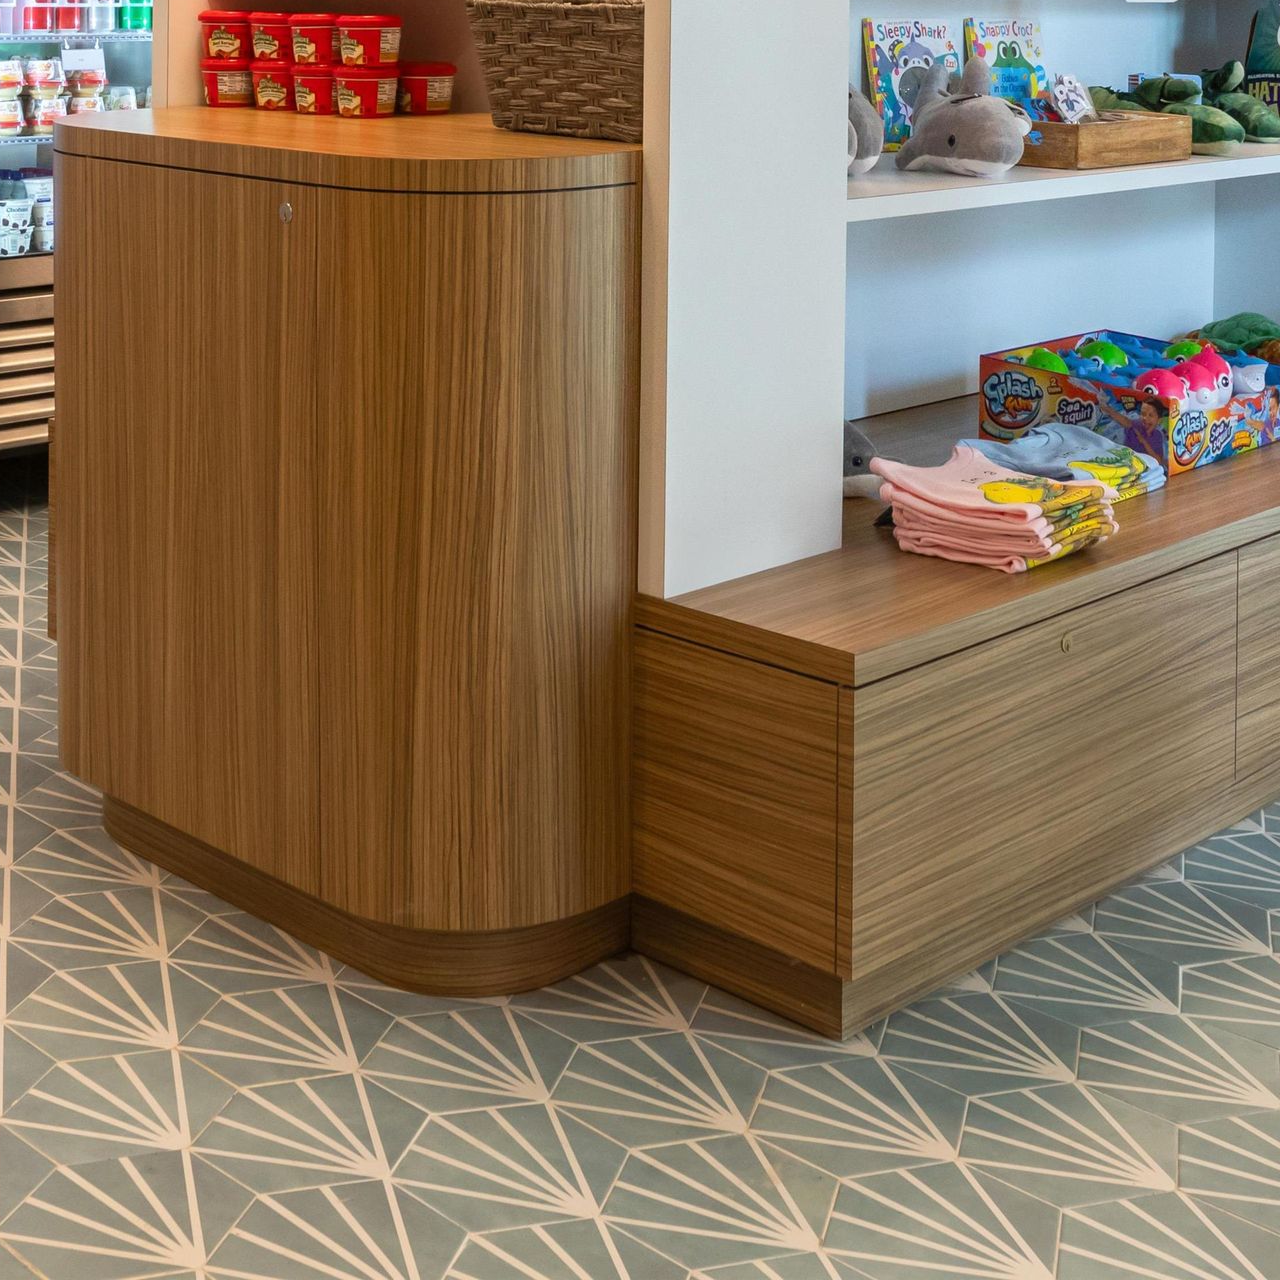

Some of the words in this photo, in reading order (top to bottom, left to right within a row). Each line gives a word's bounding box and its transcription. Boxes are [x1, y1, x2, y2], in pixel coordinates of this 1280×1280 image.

[876, 23, 912, 42] Sleepy
[913, 21, 947, 39] Shark?
[978, 22, 1011, 40] Snappy
[1011, 20, 1034, 38] Croc?
[982, 372, 1044, 416] Splash
